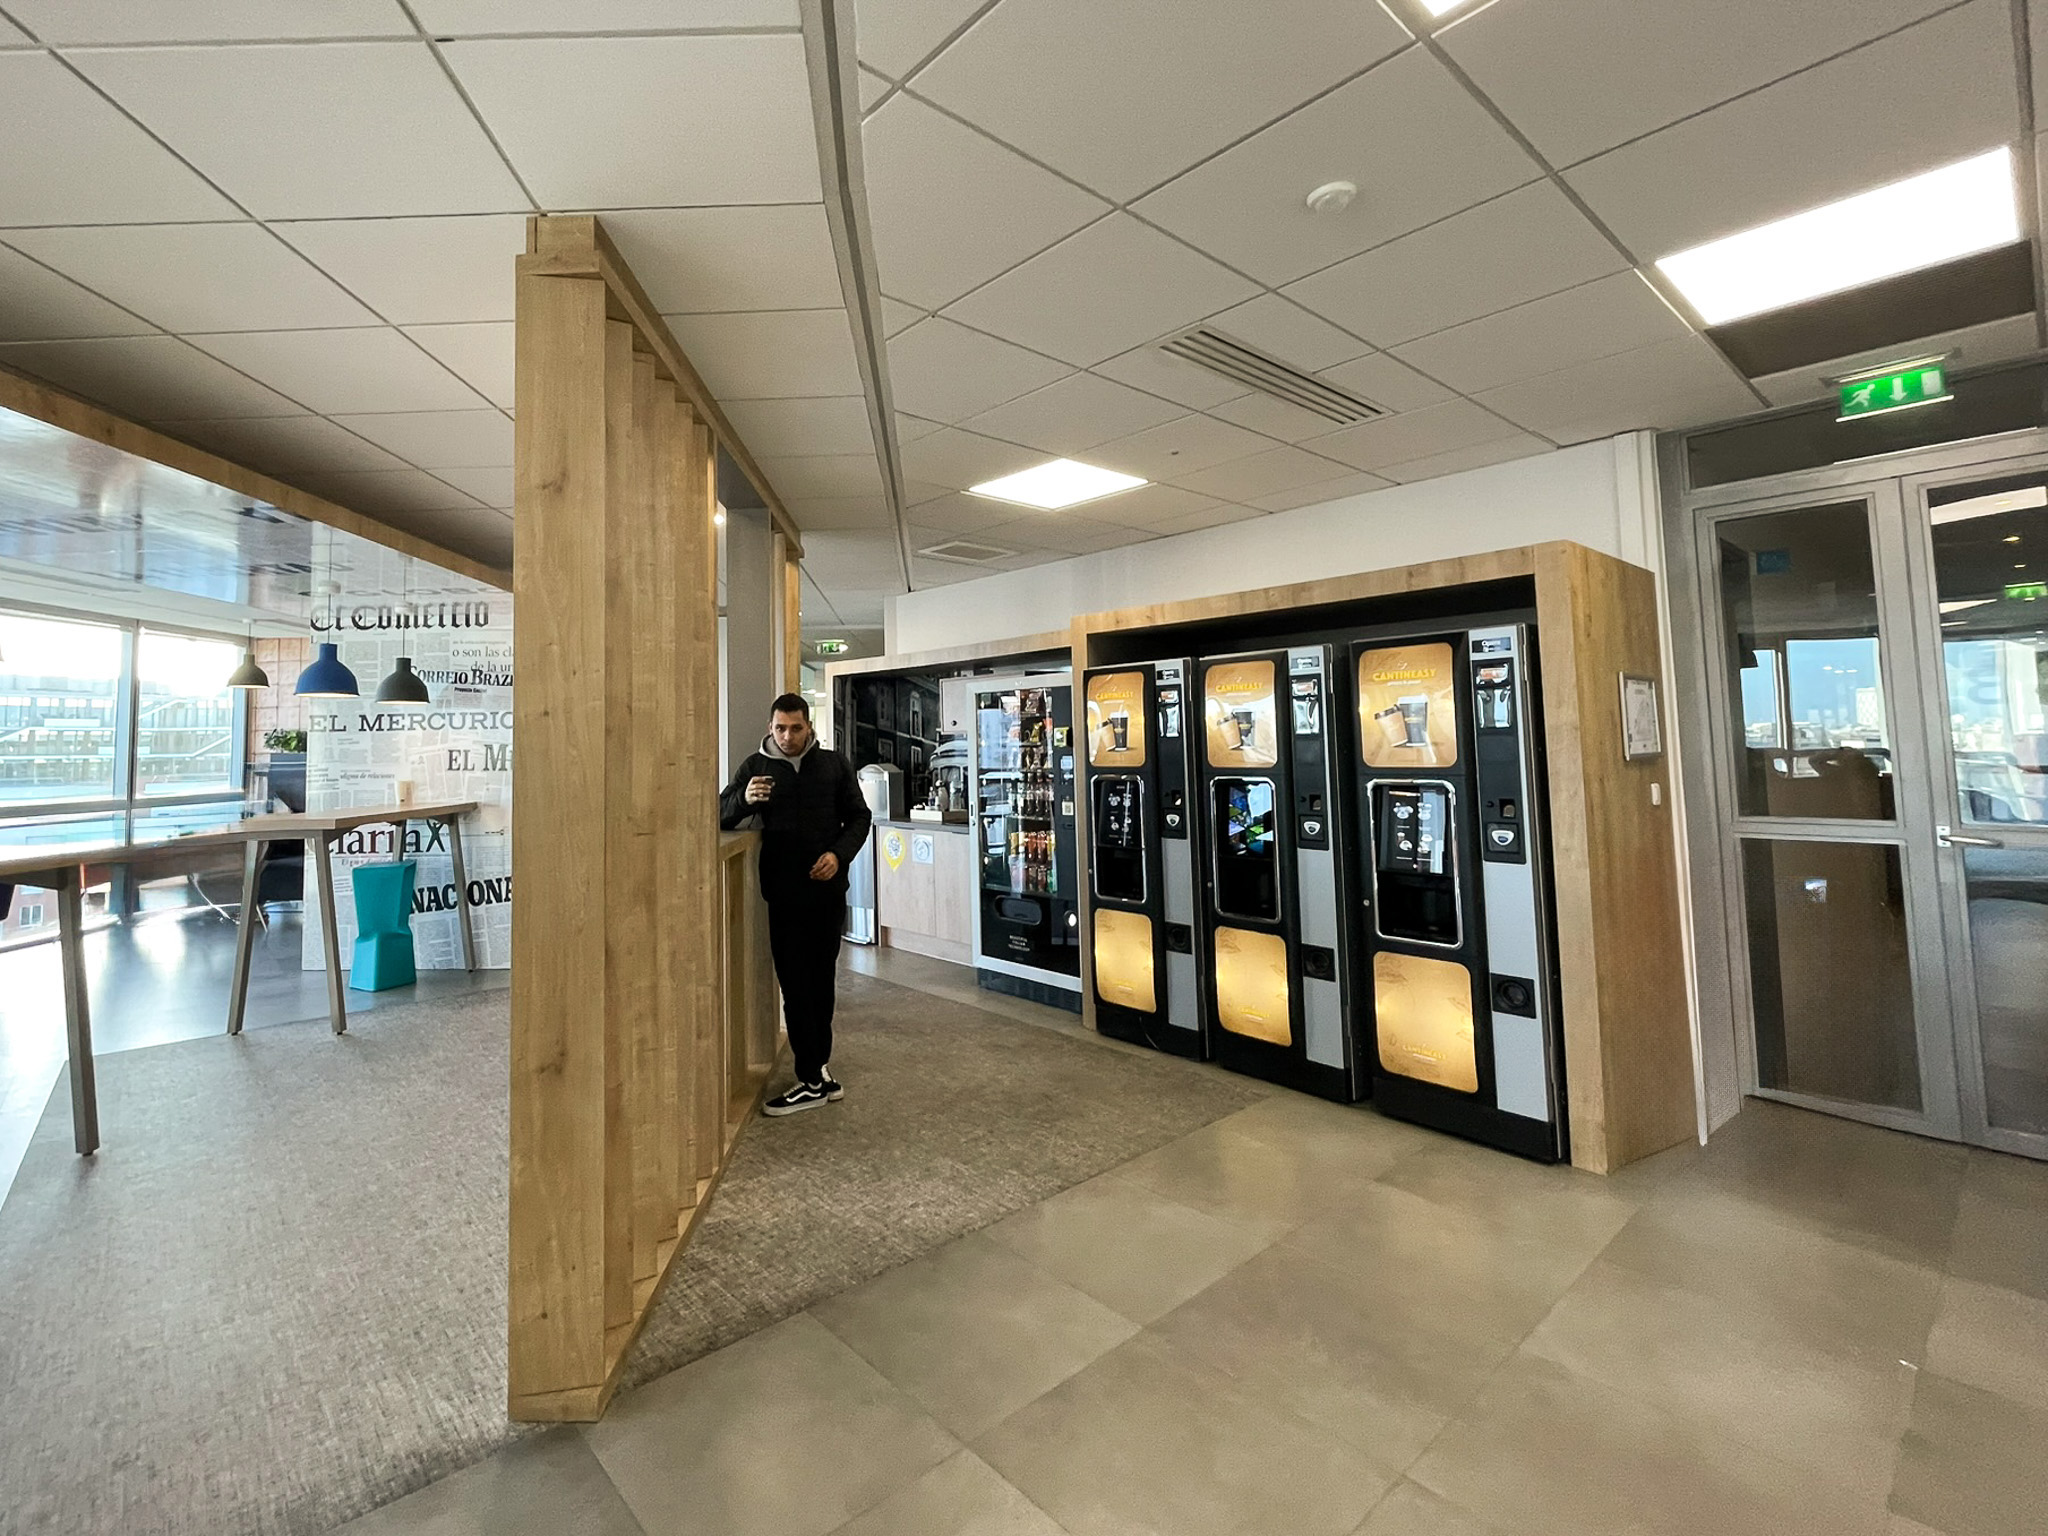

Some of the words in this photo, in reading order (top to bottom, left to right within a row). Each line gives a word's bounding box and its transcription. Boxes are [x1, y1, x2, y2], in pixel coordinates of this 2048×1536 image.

[351, 600, 489, 631] Comercio
[462, 649, 482, 657] son
[485, 645, 500, 658] las
[471, 660, 484, 671] de
[487, 660, 497, 673] la
[309, 714, 347, 732] EL
[447, 749, 475, 772] EL
